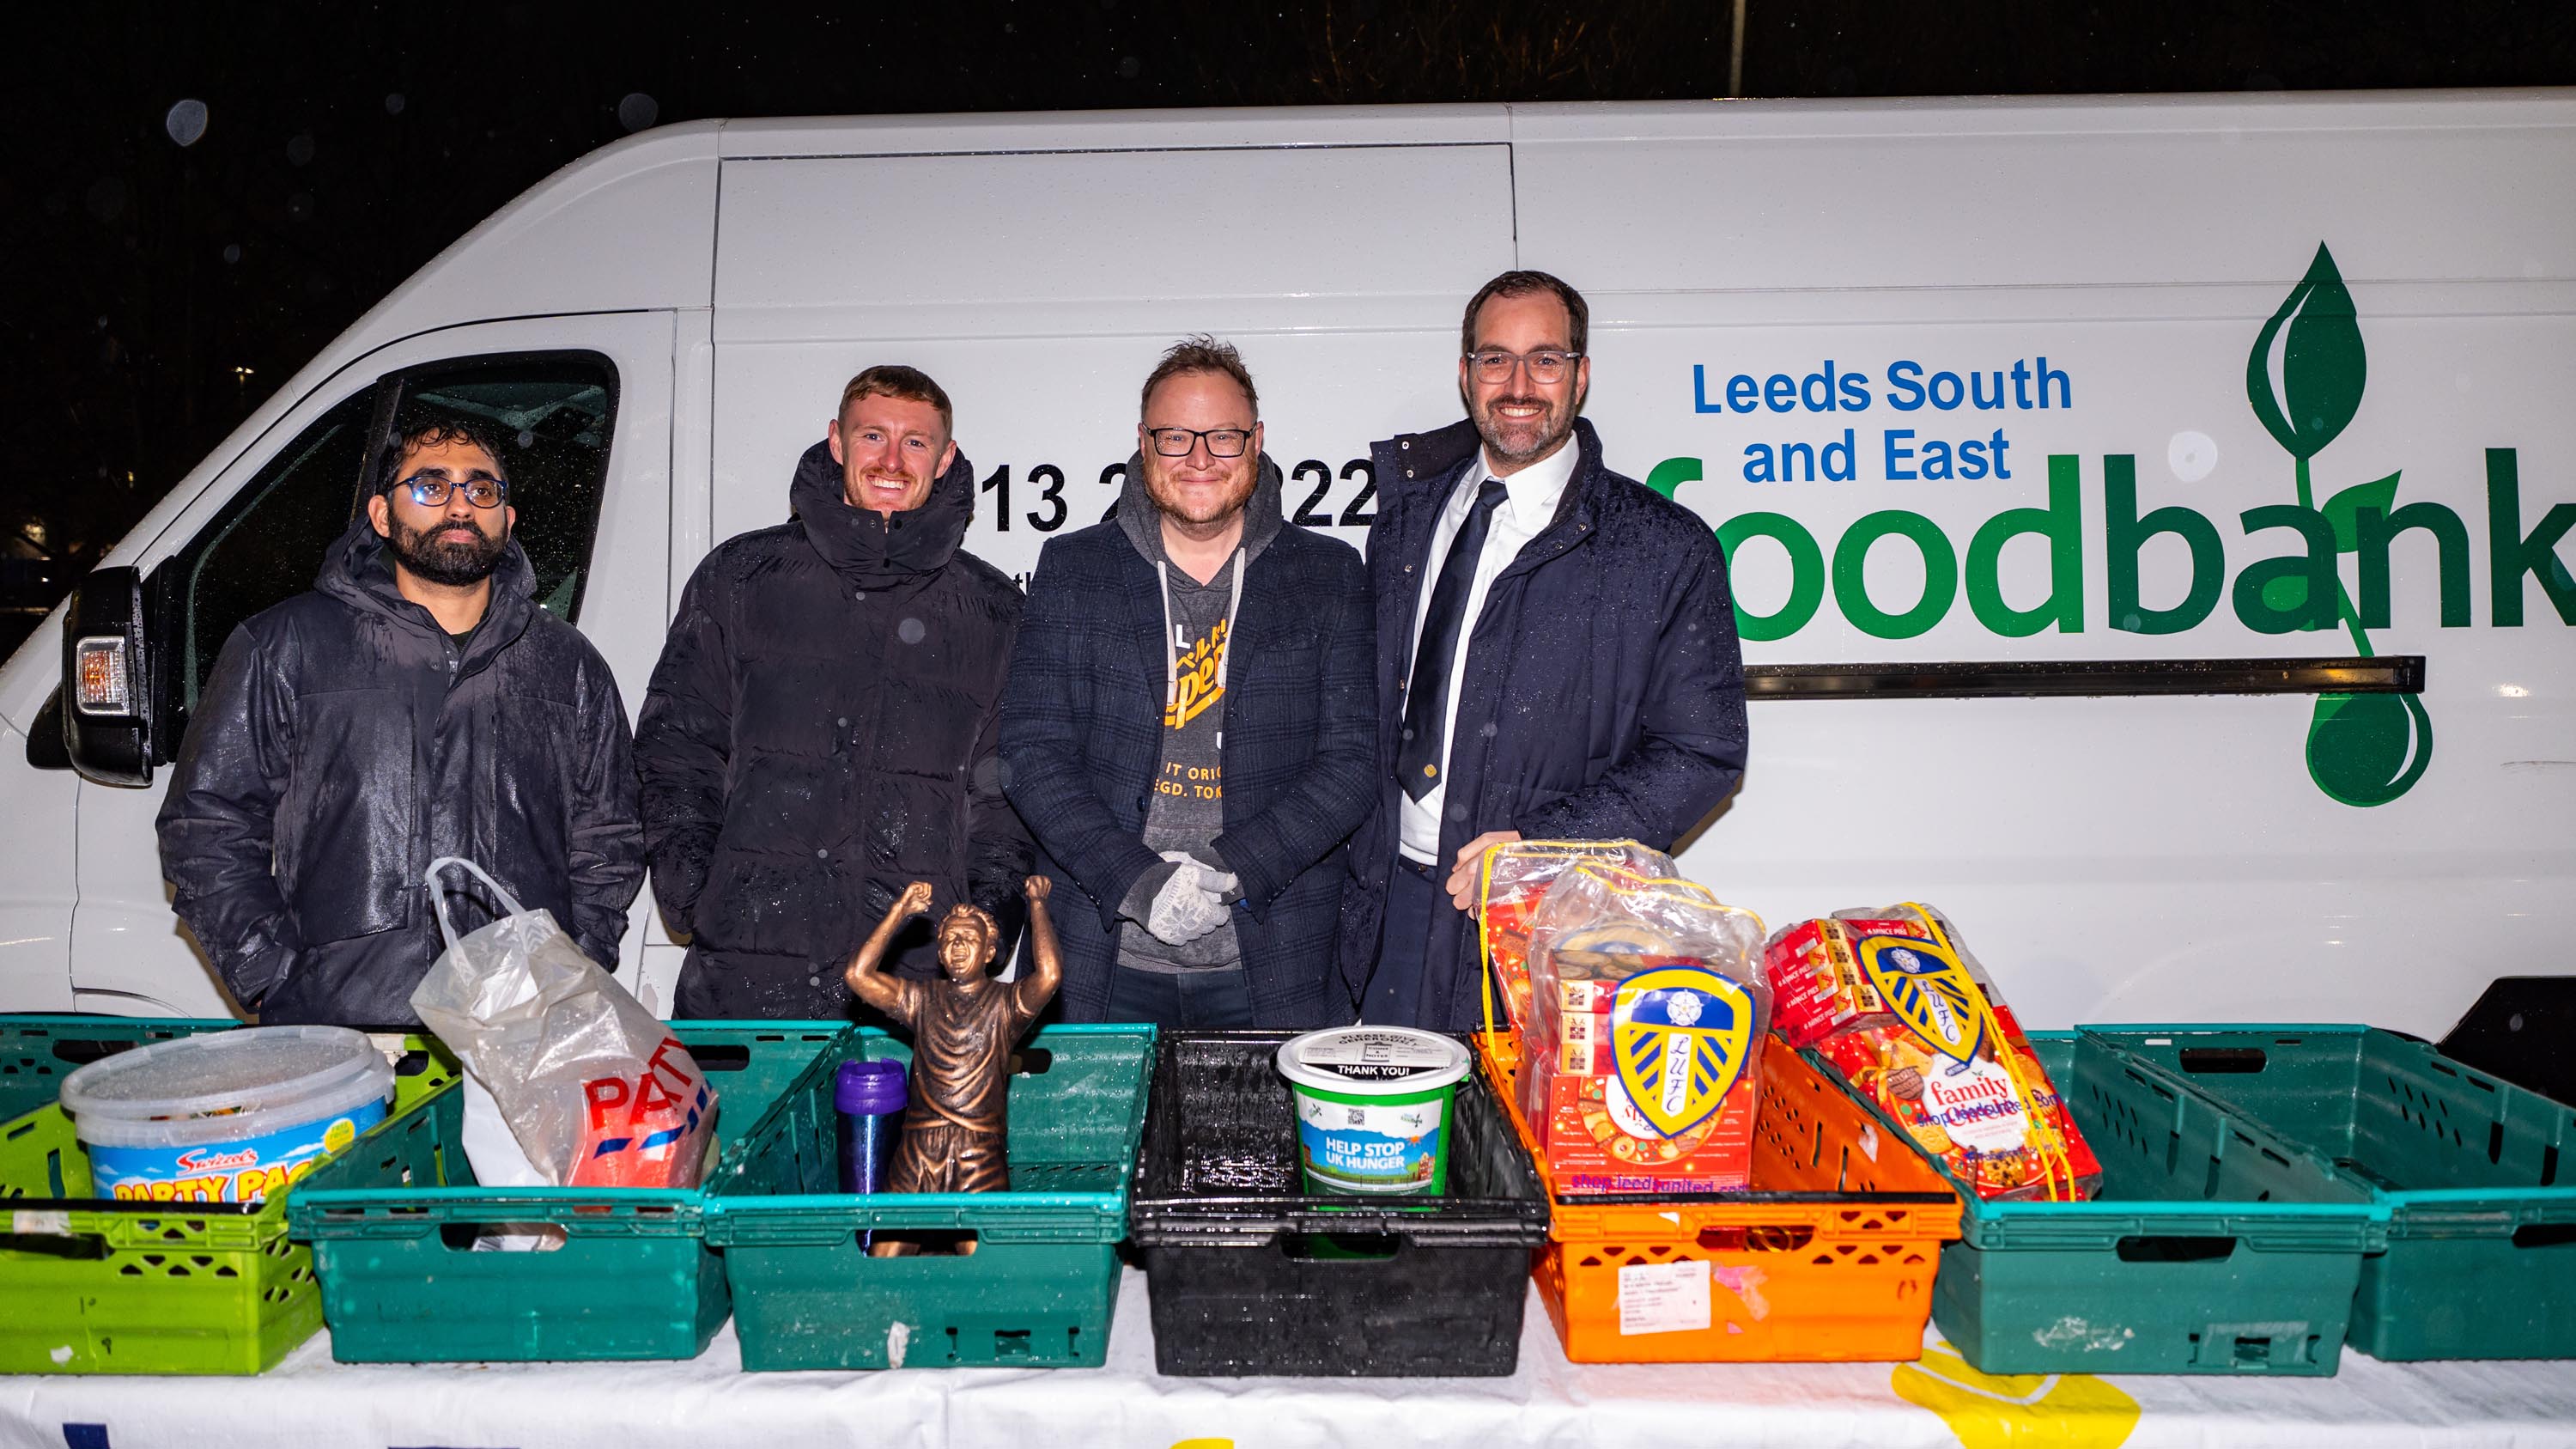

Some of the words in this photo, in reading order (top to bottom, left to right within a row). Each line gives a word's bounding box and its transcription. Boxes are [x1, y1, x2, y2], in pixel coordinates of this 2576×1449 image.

[1693, 359, 1872, 414] Leeds
[1886, 356, 2072, 411] South
[1742, 428, 1856, 483] and
[1884, 428, 2011, 481] East
[981, 464, 1068, 532] 13
[1338, 1065, 1377, 1075] THANK
[1381, 1067, 1410, 1076] YOU!
[1931, 1076, 2008, 1106] family
[1326, 1136, 1362, 1156] HELP
[1364, 1142, 1405, 1157] STOP
[1326, 1150, 1345, 1167] UK
[1346, 1156, 1405, 1169] HUNGER
